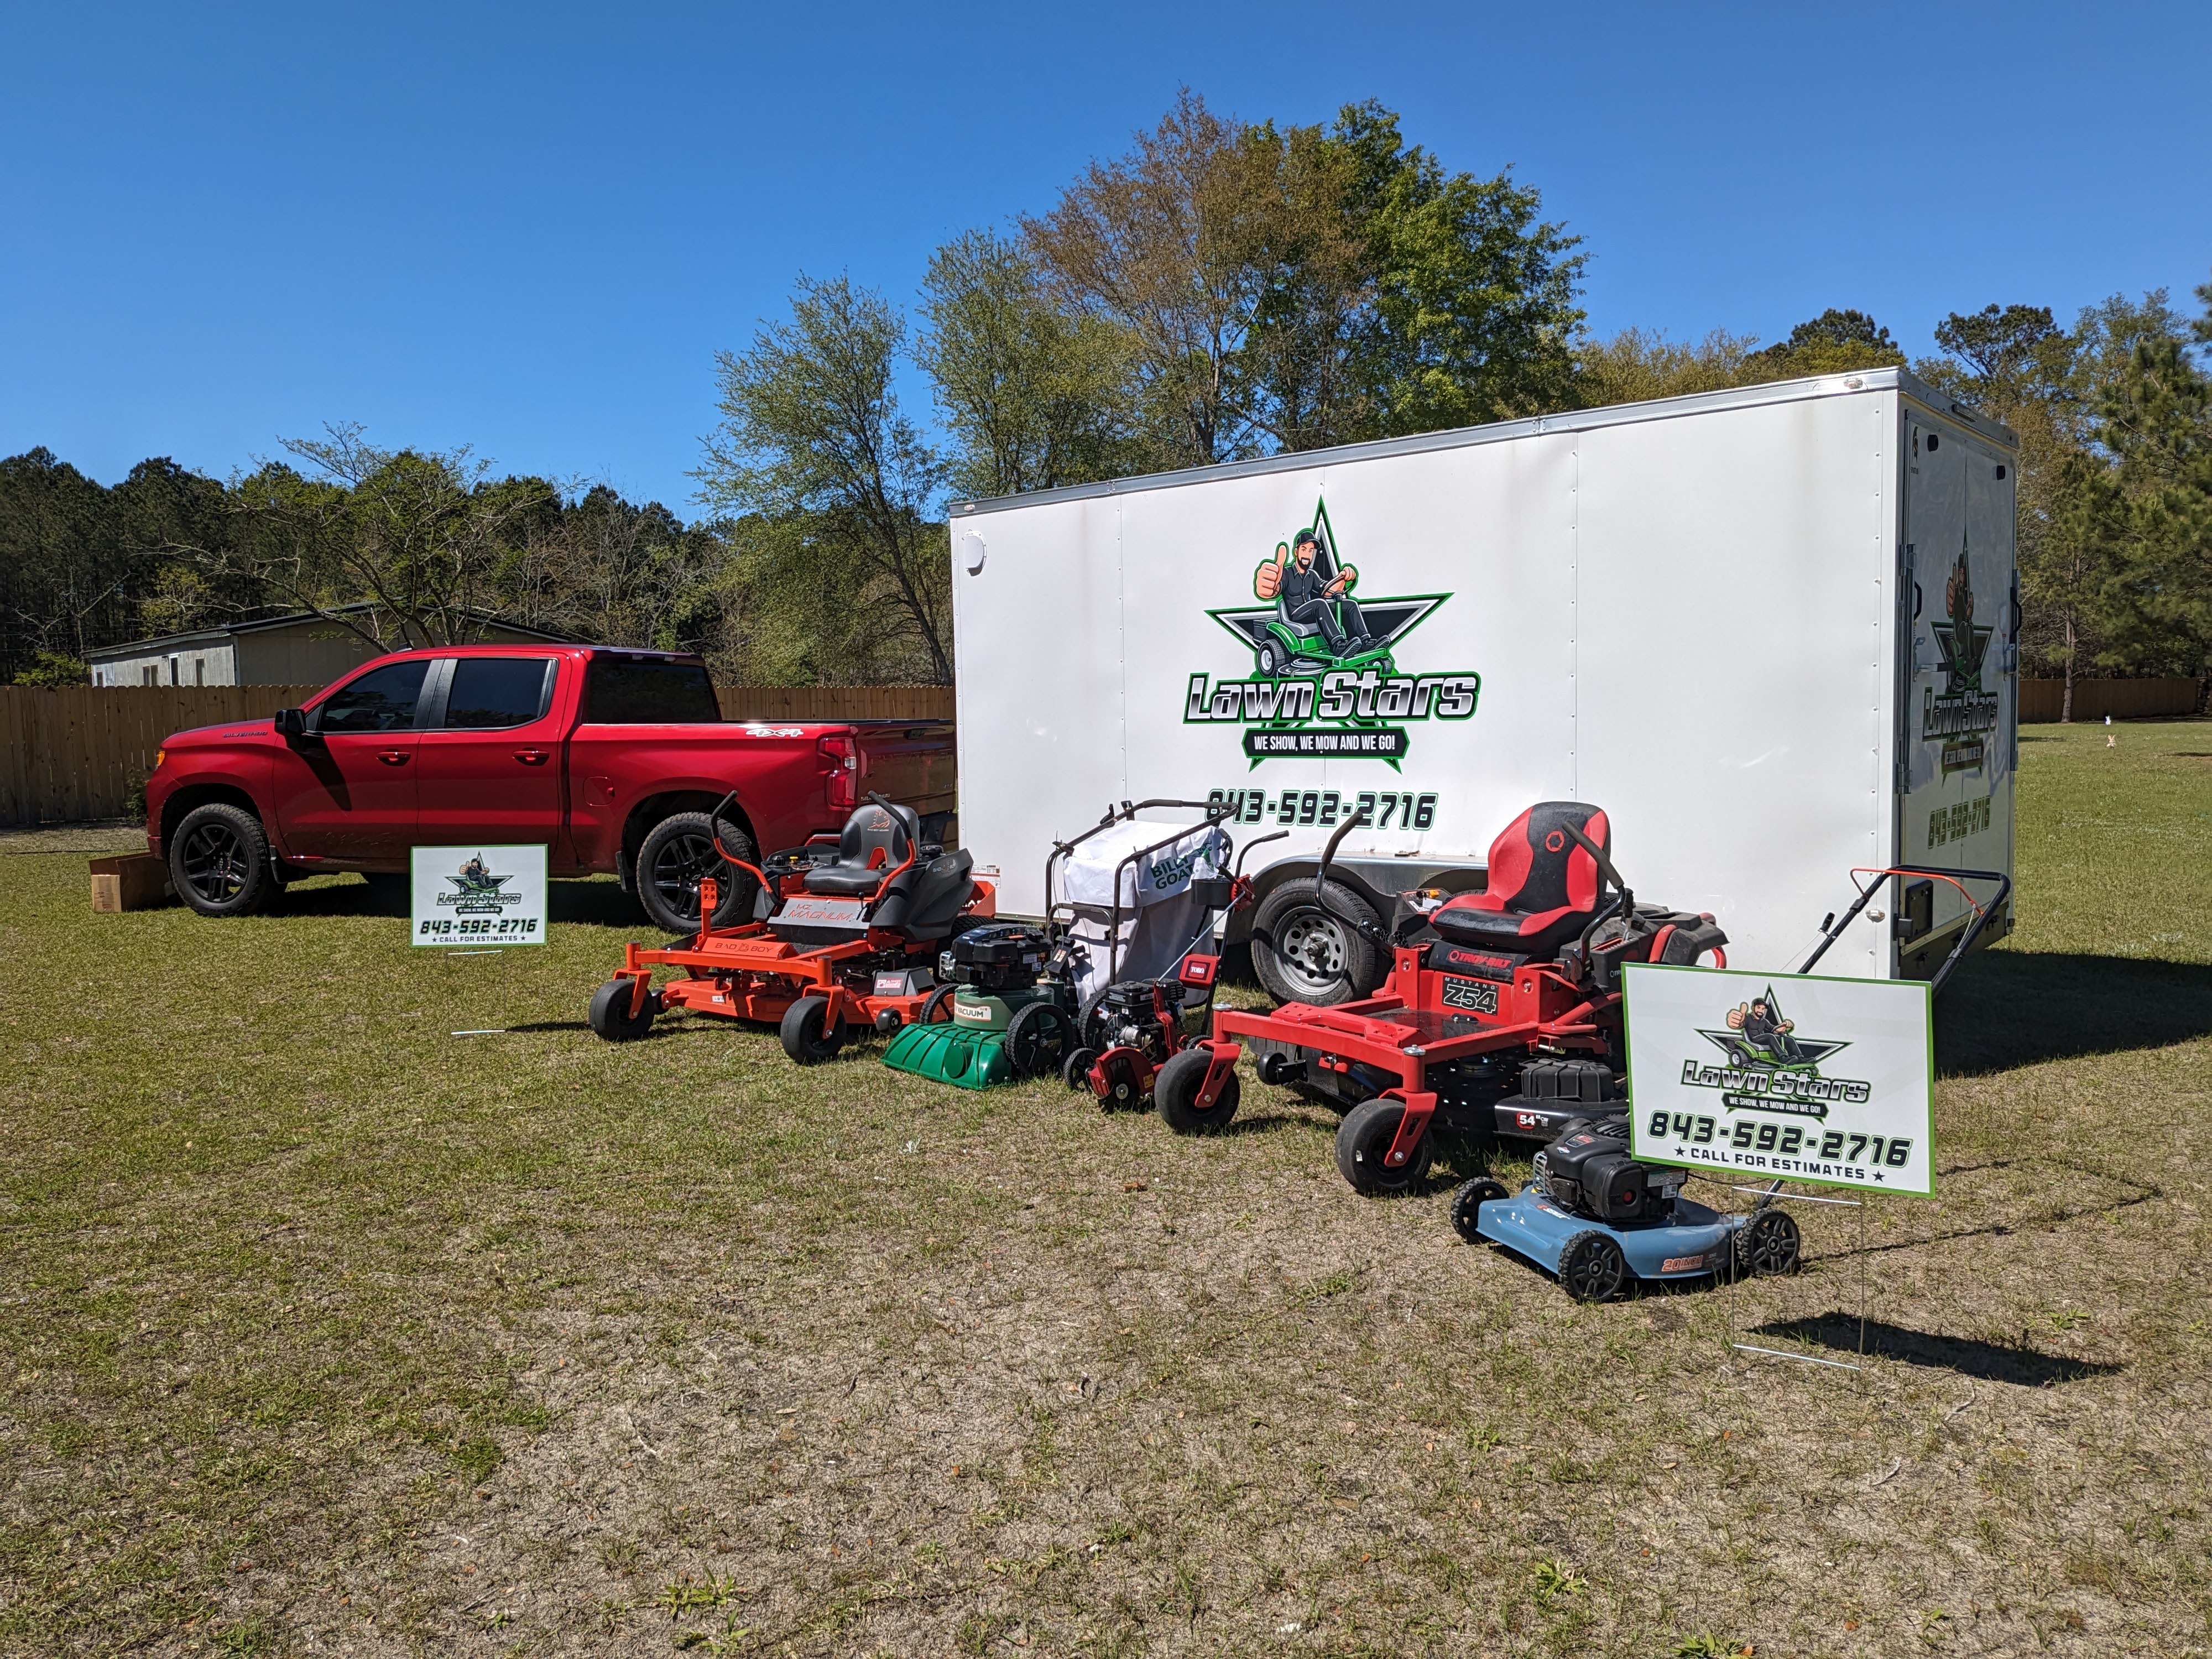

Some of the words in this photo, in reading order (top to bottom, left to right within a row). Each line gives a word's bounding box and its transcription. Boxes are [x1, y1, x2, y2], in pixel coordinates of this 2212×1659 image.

[1184, 672, 1314, 724] Lawn
[1317, 670, 1479, 721] Stars
[1923, 691, 1962, 737] Lawn
[1962, 689, 1998, 731] Stars
[1254, 736, 1267, 750] WE
[1270, 736, 1298, 752] SHOW,
[1300, 736, 1313, 750] WE
[1316, 735, 1338, 750] MOW
[1340, 735, 1359, 750] AND
[1361, 735, 1376, 750] WE
[1379, 735, 1395, 750] GO!
[1928, 795, 1991, 849] 843-592-2716
[1150, 855, 1188, 878] BILLY
[1155, 863, 1194, 890] GOAT
[437, 893, 478, 905] Lawn
[478, 892, 521, 904] Stars
[419, 918, 539, 935] 843-592-2716
[787, 910, 853, 920] MAGNUM
[1458, 952, 1512, 968] TROY-BILT
[1444, 977, 1495, 990] MUSTANG
[1443, 984, 1496, 1014] Z54
[957, 1006, 983, 1018] VACUUM
[1682, 1061, 1770, 1092] Lawn
[1771, 1070, 1870, 1103] Stars
[1739, 1098, 1758, 1107] SHOW,
[1759, 1100, 1768, 1108] WE
[1770, 1101, 1785, 1109] MOW
[1786, 1103, 1798, 1111] AND
[1810, 1105, 1821, 1114] GO!
[1647, 1110, 1913, 1168] 843-592-2716
[1691, 1147, 1730, 1163] CALL
[1735, 1154, 1766, 1167] FOR
[1772, 1158, 1865, 1180] ESTIMATES
